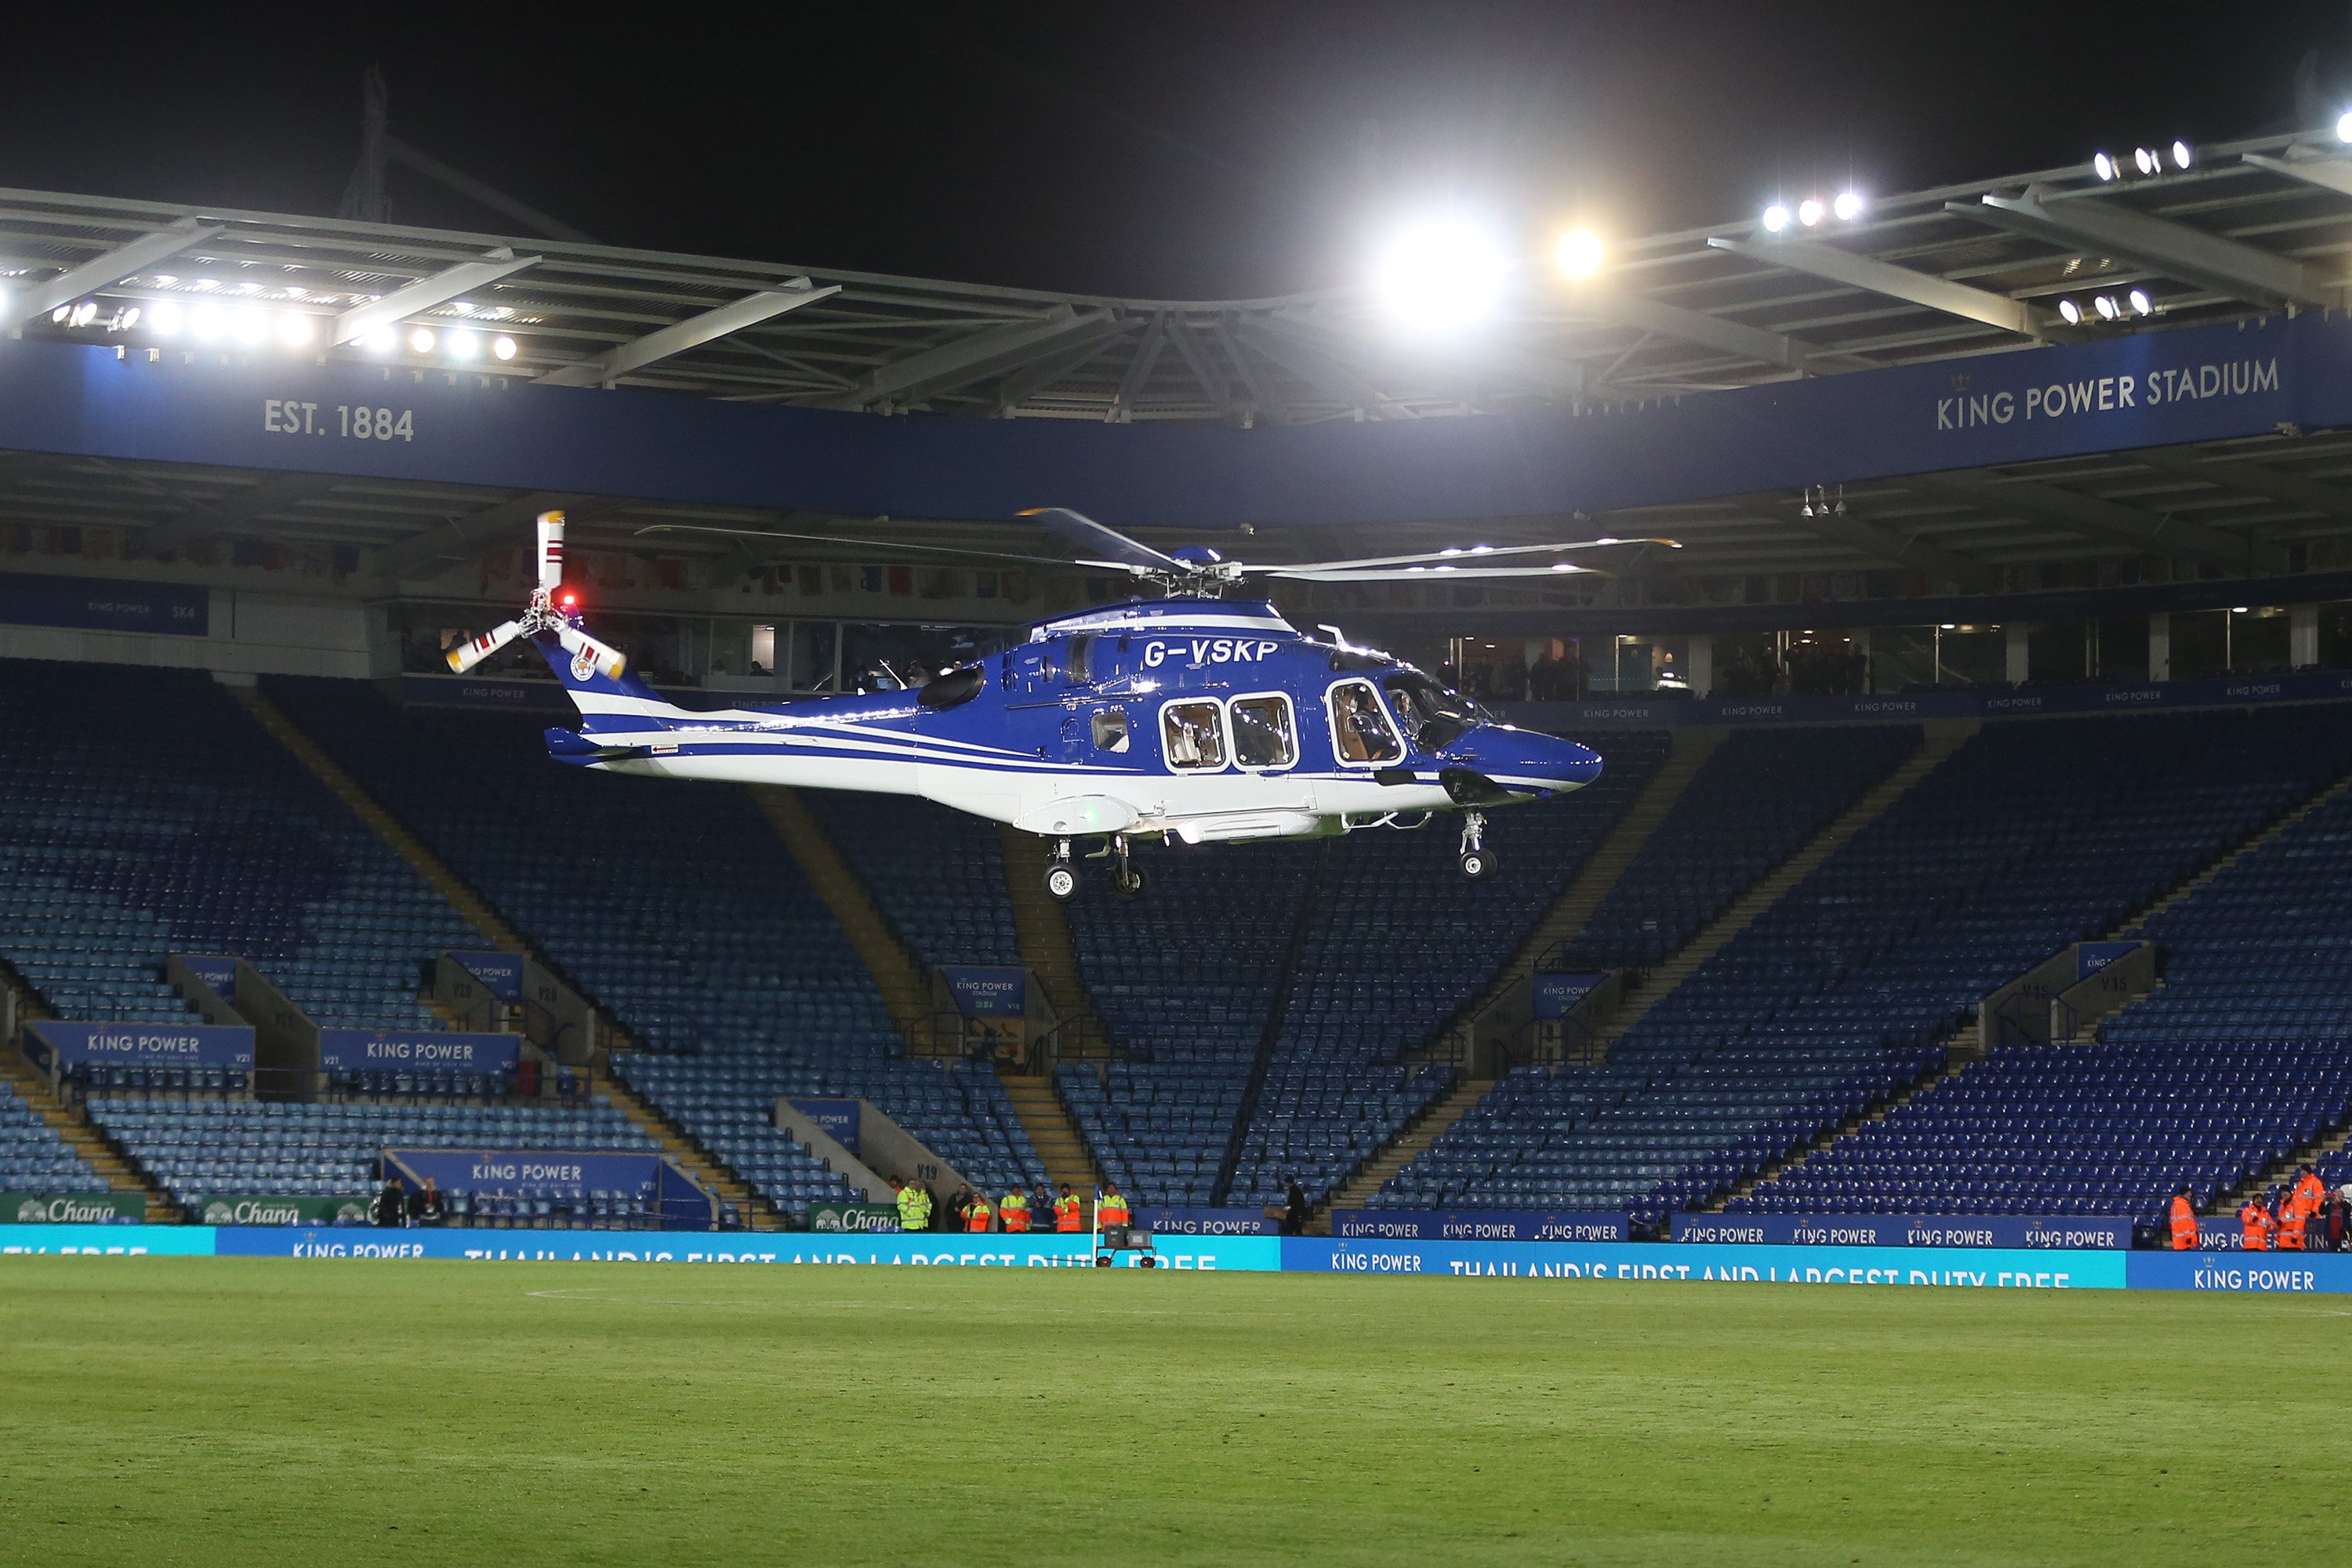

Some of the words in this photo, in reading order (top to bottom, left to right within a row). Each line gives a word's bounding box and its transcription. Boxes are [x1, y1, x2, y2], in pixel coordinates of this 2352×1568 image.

[1937, 391, 2015, 430] KING
[2027, 376, 2136, 420] POWER
[2147, 357, 2279, 405] STADIUM
[265, 399, 325, 436] EST.
[337, 405, 415, 442] 1884
[89, 602, 114, 612] KING
[115, 603, 151, 614] POWER
[172, 606, 195, 619] SK4
[1144, 639, 1279, 668] G-VSKP
[463, 688, 488, 697] KING
[491, 688, 525, 699] POWER
[2106, 692, 2128, 702] KING
[2130, 691, 2161, 700] POWER
[2227, 686, 2249, 695] KING
[2252, 684, 2281, 694] POWER
[1722, 706, 1747, 716] KING
[1749, 706, 1782, 715] POWER
[1882, 702, 1916, 710] POWER
[1987, 699, 2009, 709] KING
[2012, 698, 2042, 707] POWER
[1584, 710, 1610, 718] KING
[1613, 709, 1650, 717] POWER
[956, 982, 979, 990] KING
[982, 982, 1013, 991] POWER
[87, 1034, 133, 1051] KING
[137, 1036, 200, 1053] POWER
[366, 1043, 411, 1058] KING
[414, 1044, 473, 1060] POWER
[472, 1164, 517, 1180] KING
[521, 1164, 582, 1181] POWER
[916, 1163, 938, 1181] V19
[1152, 1220, 1197, 1234] KING
[1341, 1223, 1374, 1237] KING
[1379, 1223, 1418, 1237] POWER
[1443, 1224, 1472, 1238] KING
[1475, 1224, 1516, 1239] POWER
[1541, 1225, 1572, 1240] KING
[1575, 1225, 1617, 1240] POWER
[1683, 1228, 1716, 1243] KING
[1719, 1228, 1764, 1243] POWER
[1793, 1229, 1826, 1244] KING
[1830, 1229, 1876, 1244] POWER
[1907, 1229, 1942, 1245] KING
[1945, 1230, 1994, 1246] POWER
[2025, 1231, 2062, 1247] KING
[2065, 1231, 2114, 1247] POWER
[2198, 1232, 2227, 1247] ING
[292, 1243, 347, 1258] KING
[353, 1243, 424, 1259] POWER
[1331, 1253, 1367, 1271] KING
[1372, 1254, 1421, 1272] POWER
[2194, 1269, 2242, 1290] KING
[2248, 1270, 2314, 1290] POWER
